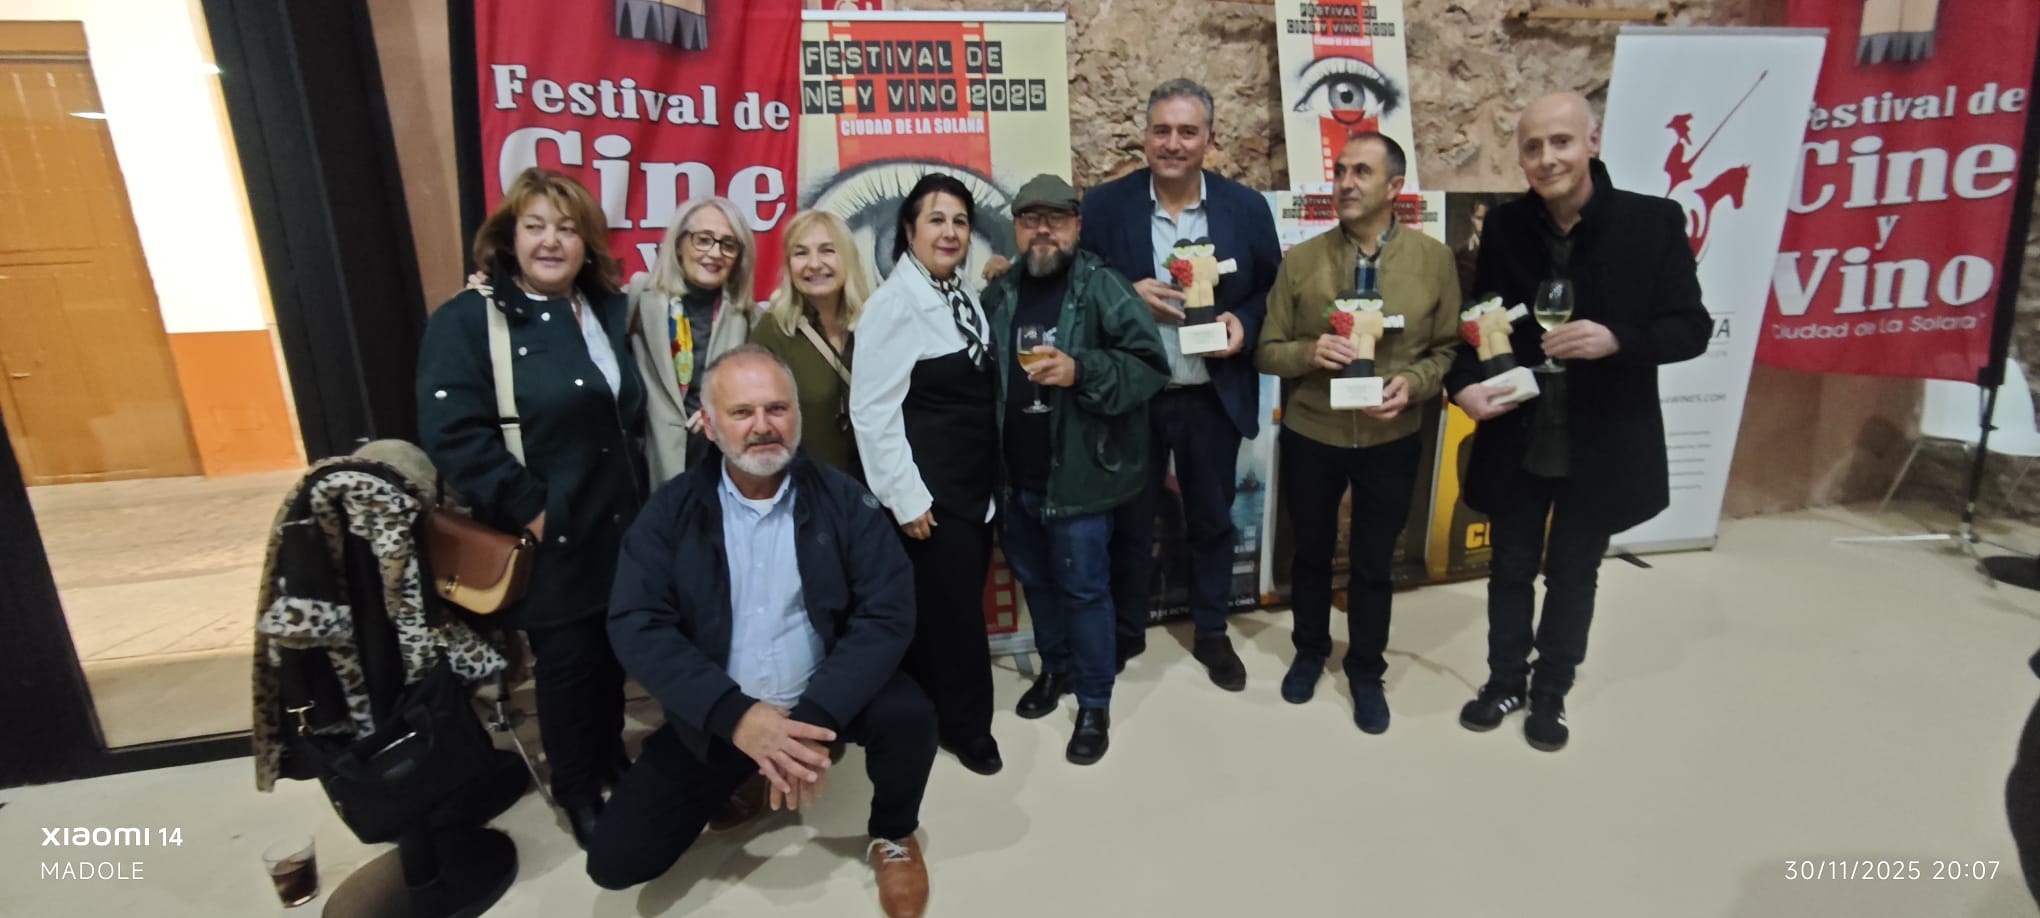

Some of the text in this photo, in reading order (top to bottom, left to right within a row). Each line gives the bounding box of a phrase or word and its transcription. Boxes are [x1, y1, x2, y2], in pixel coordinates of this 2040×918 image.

[1332, 22, 1361, 35] VINO
[804, 46, 1001, 69] FESTIVAL DE
[491, 64, 791, 131] Festival de
[803, 84, 1045, 106] NE Y VINO 2025
[1810, 83, 2026, 130] estival de
[840, 117, 984, 136] CIUDAD DE LA SOLANA
[1788, 136, 2017, 214] Cine
[1875, 215, 1899, 250] y
[1772, 247, 1994, 316] Vino
[1854, 321, 1876, 336] de
[1879, 318, 1903, 333] La
